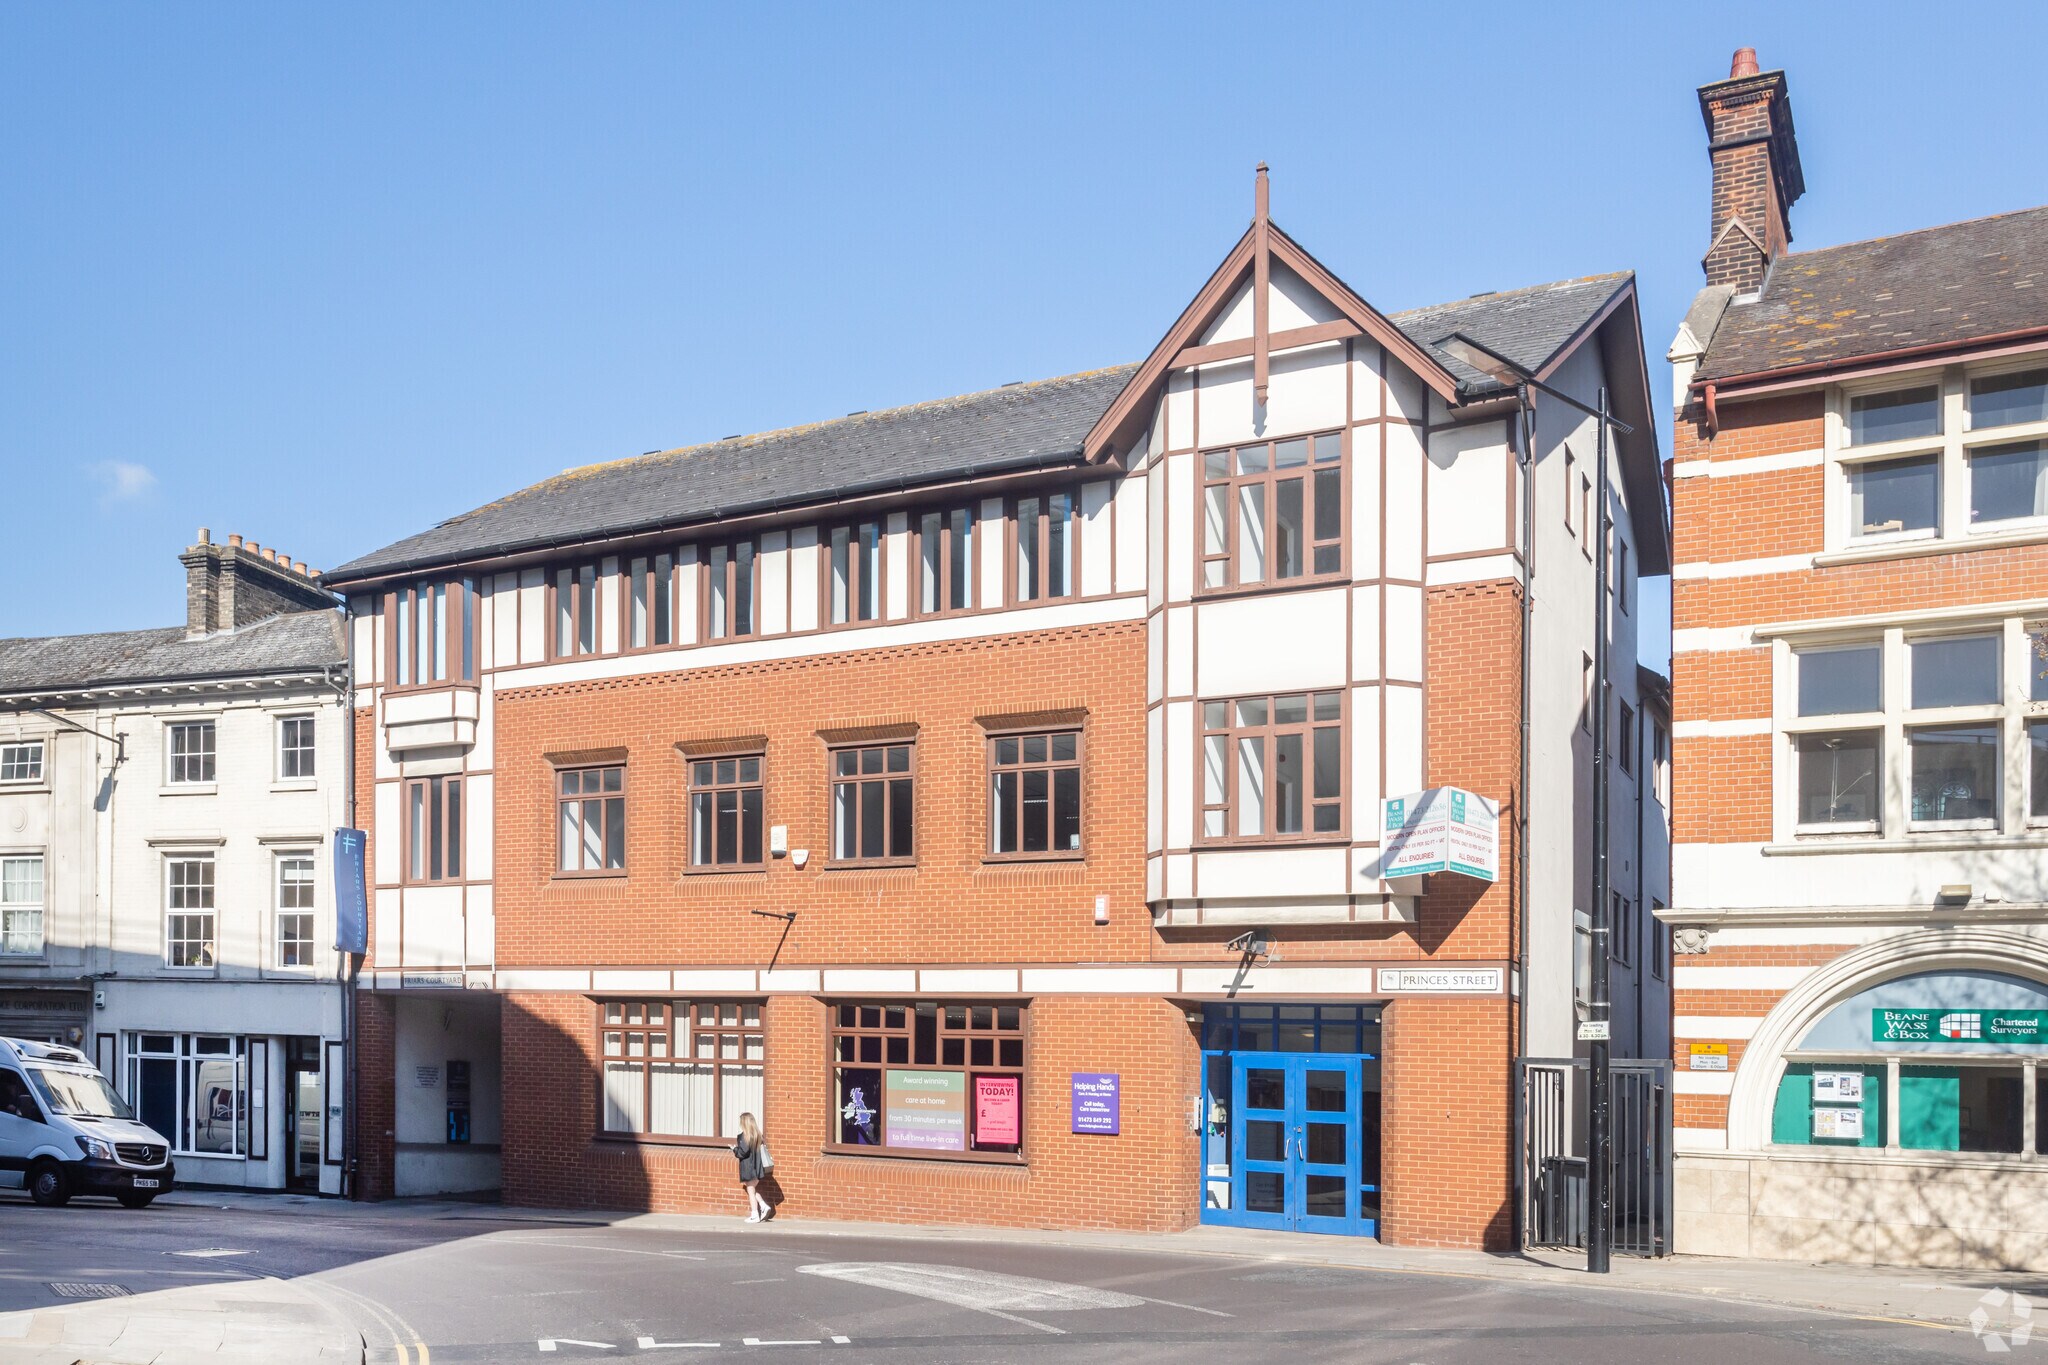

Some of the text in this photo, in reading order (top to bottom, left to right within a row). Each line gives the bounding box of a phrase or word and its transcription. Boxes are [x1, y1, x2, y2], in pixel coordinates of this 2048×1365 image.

[1409, 852, 1434, 861] ENQUIRIES
[1403, 976, 1494, 985] PRINCES STREET
[15, 1001, 65, 1010] CORPORATION
[1884, 1012, 1929, 1020] BEANE
[1886, 1021, 1927, 1029] WASS
[1993, 1018, 2038, 1026] Chartered
[1991, 1026, 2037, 1035] Surveyors
[924, 1077, 948, 1086] winning
[1075, 1083, 1096, 1091] Helping
[980, 1088, 1013, 1096] TODAY!
[913, 1115, 935, 1123] minutes
[911, 1134, 924, 1142] time
[926, 1134, 944, 1143] live-in
